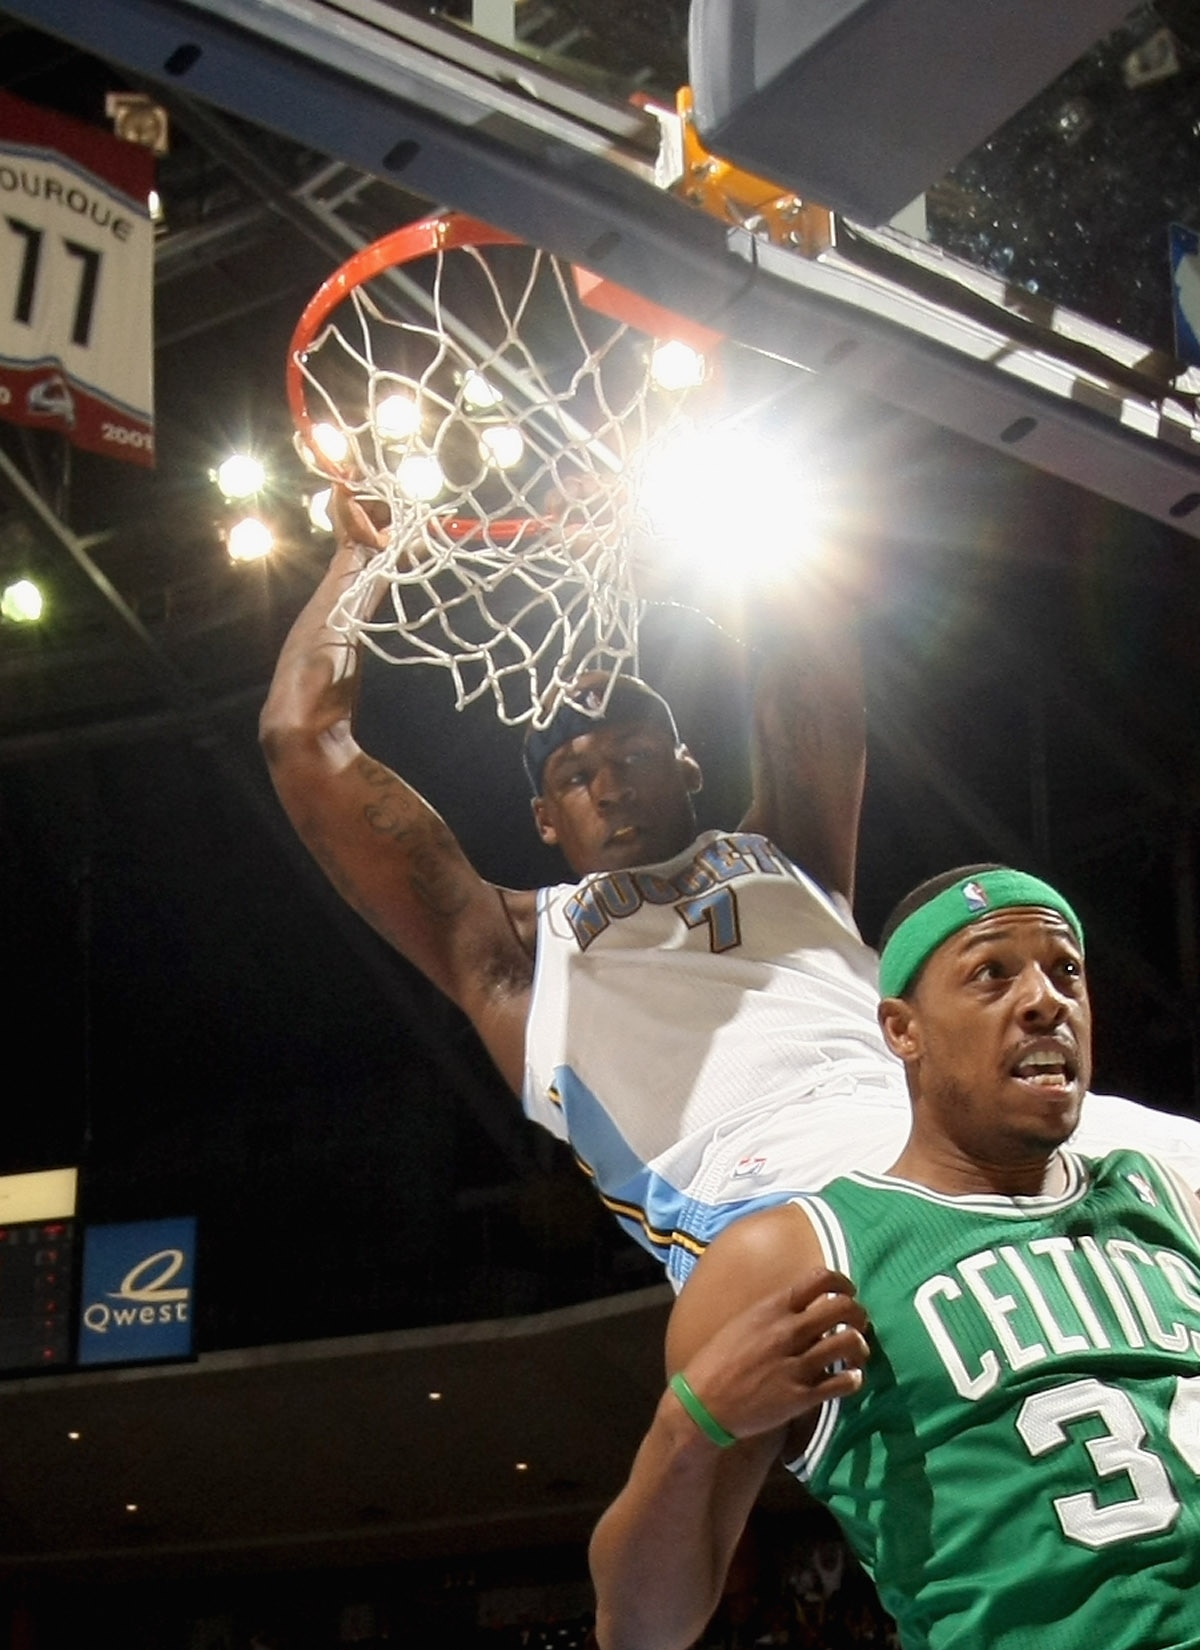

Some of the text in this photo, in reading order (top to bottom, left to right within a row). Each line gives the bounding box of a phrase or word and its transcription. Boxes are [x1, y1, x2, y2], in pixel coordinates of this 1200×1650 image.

[4, 213, 104, 348] 77
[674, 884, 742, 954] 7
[84, 1303, 188, 1333] Qwest
